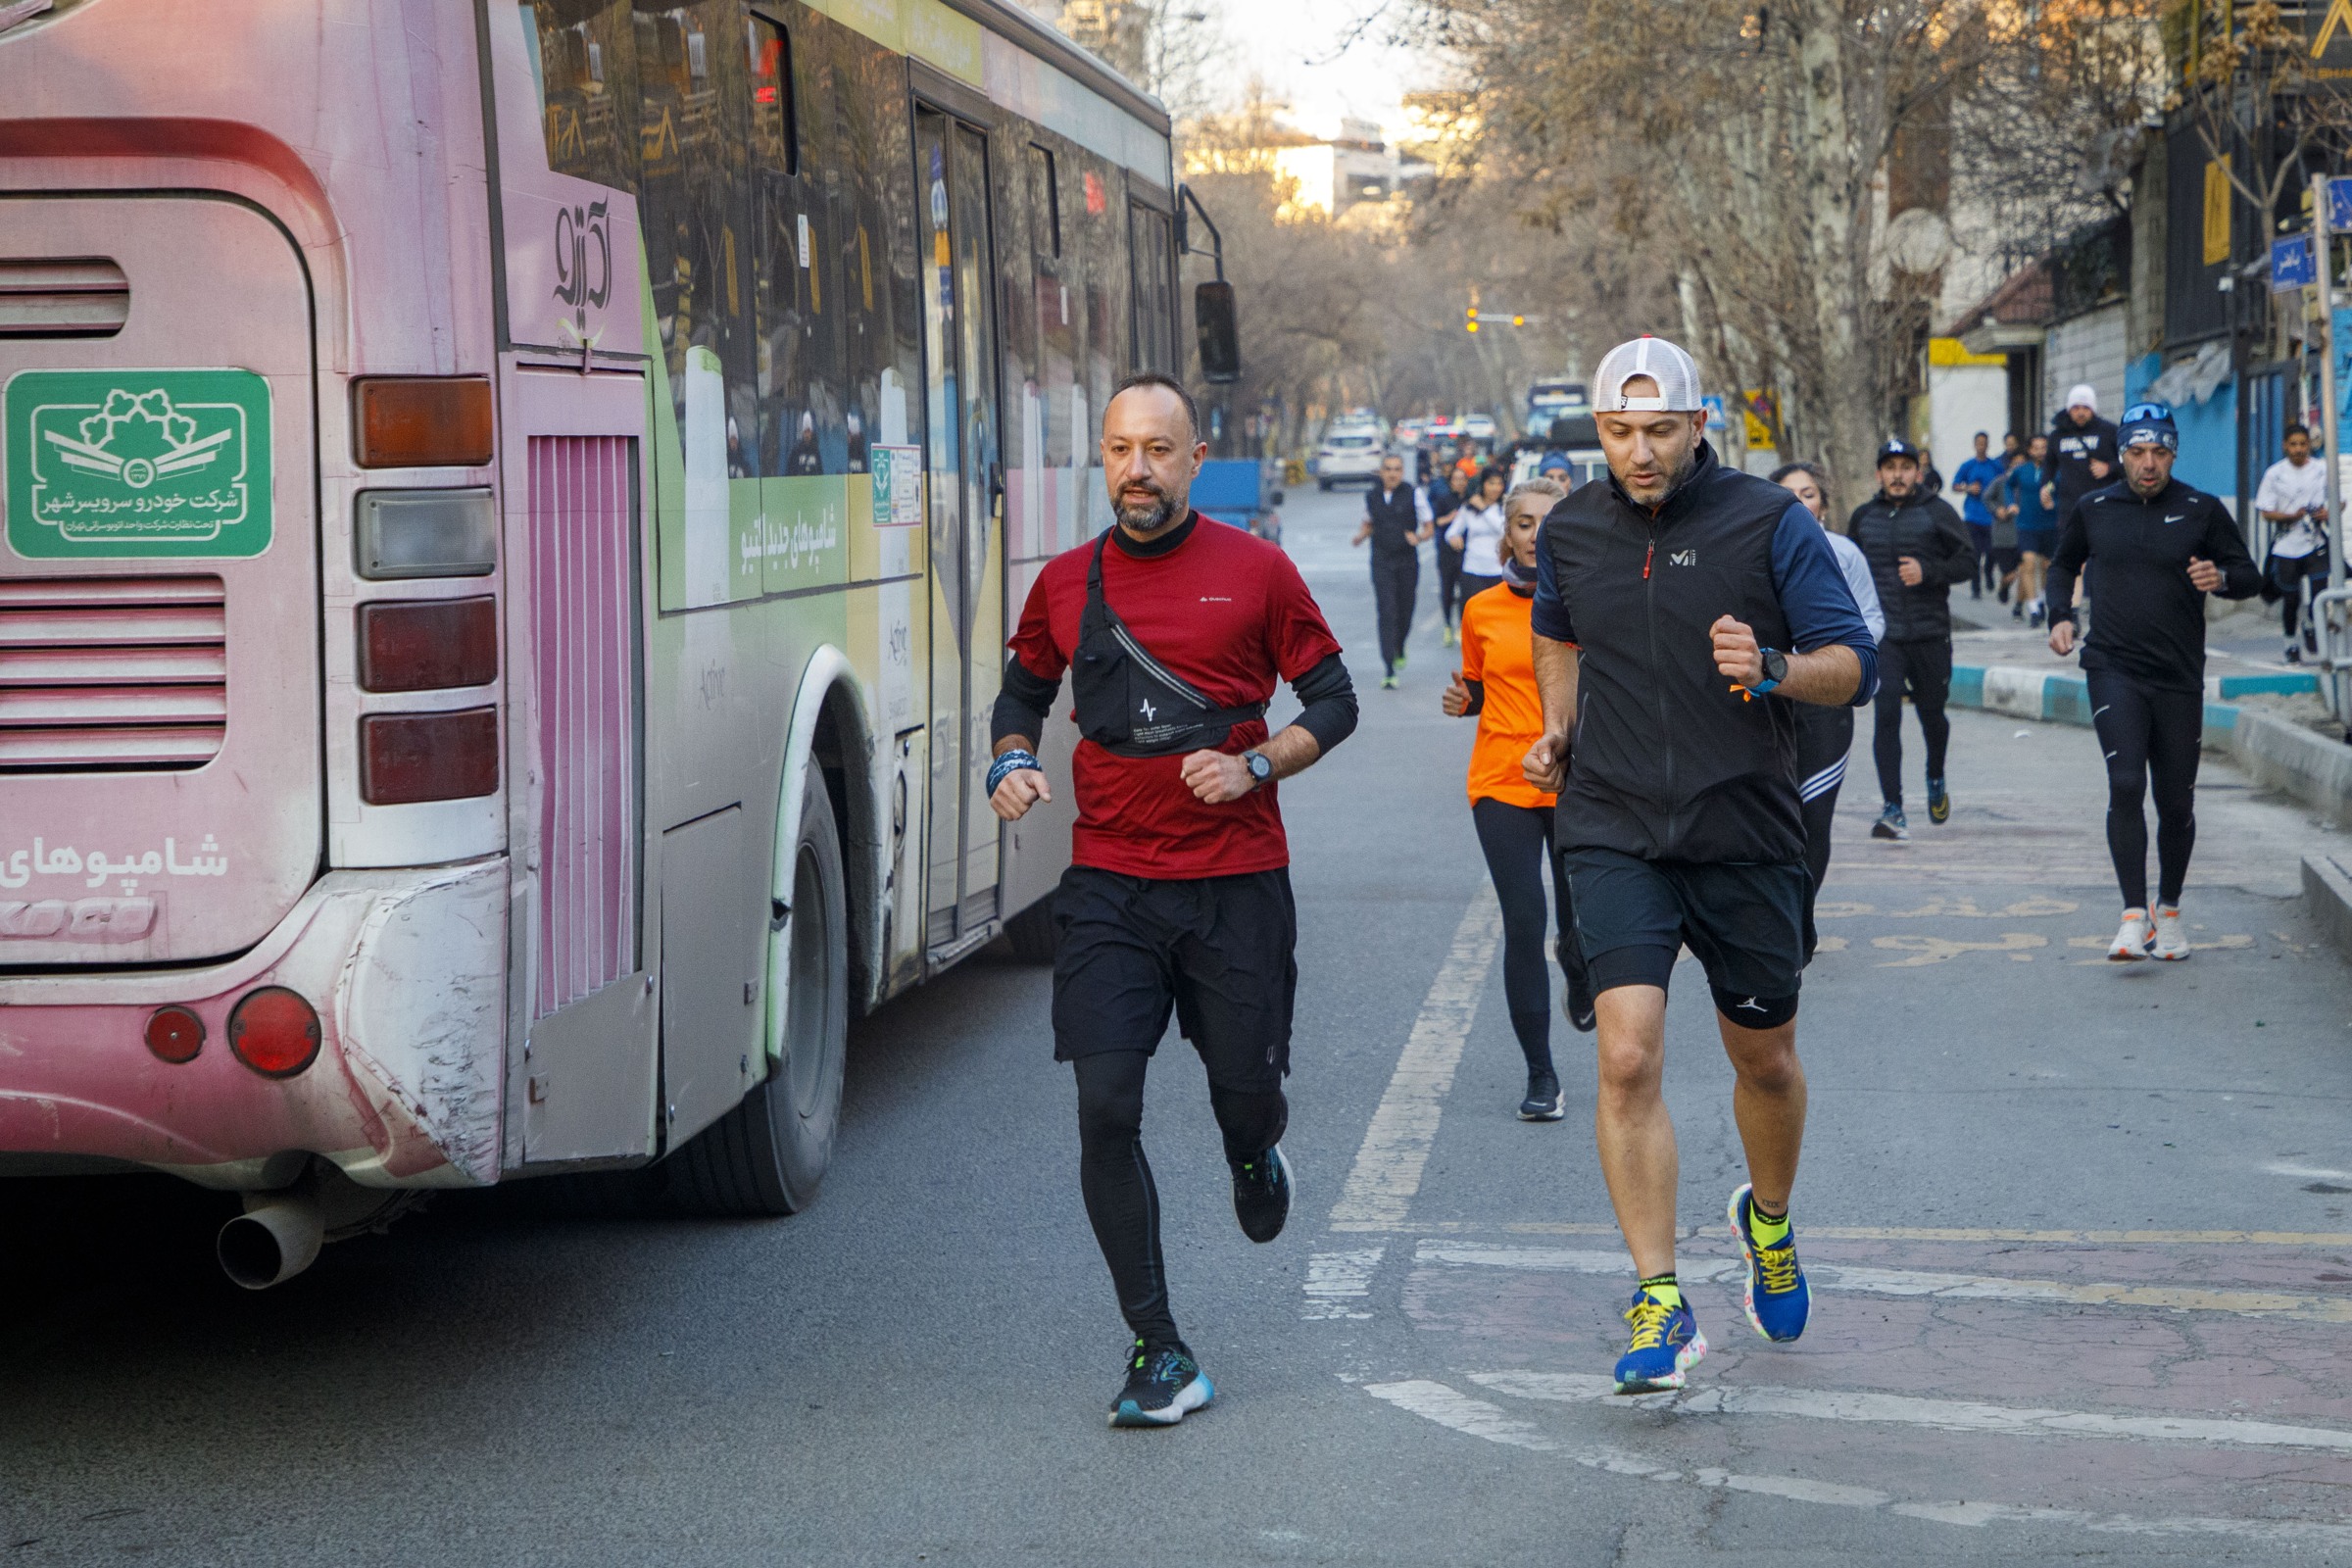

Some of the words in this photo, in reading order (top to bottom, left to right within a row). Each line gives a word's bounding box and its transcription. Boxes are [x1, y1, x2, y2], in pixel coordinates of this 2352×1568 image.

[40, 492, 75, 514] شهر
[133, 493, 186, 514] خودرو
[188, 489, 239, 513] شرکت
[767, 521, 790, 570] جدید
[790, 503, 836, 574] شامپوهای
[0, 833, 227, 896] شامپوهای
